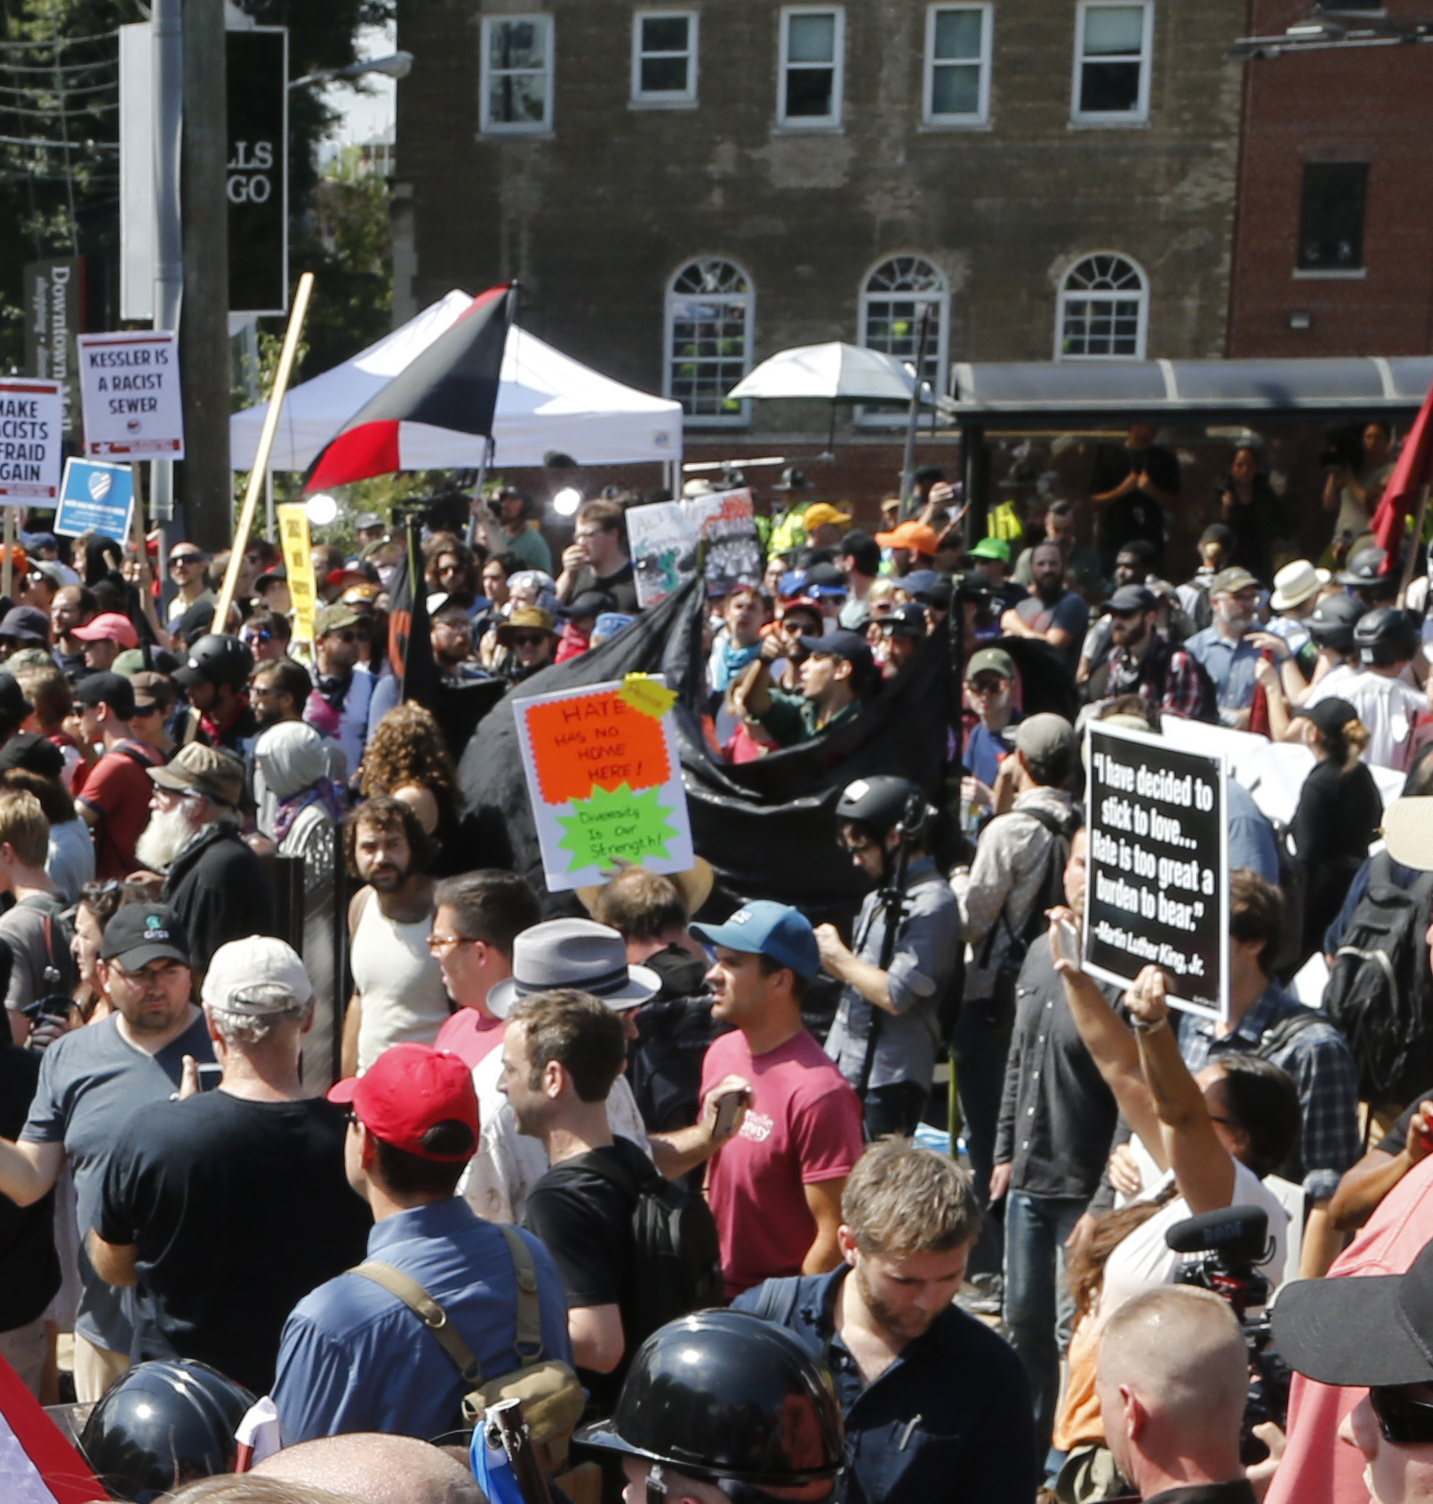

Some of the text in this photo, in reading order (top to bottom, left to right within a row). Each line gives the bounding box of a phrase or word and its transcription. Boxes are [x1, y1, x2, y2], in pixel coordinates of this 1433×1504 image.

[51, 265, 71, 381] Downtown
[89, 347, 169, 368] KESSLER IS
[98, 373, 164, 393] A RACIST
[108, 397, 158, 416] SEWER
[561, 700, 627, 723] HATE
[554, 725, 620, 748] HAS NO
[577, 742, 626, 760] HOME
[1105, 755, 1135, 793] have
[1136, 763, 1192, 808] decided
[1194, 777, 1214, 812] to
[579, 806, 640, 826] Diversity
[1101, 795, 1132, 832] stick
[1134, 803, 1149, 837] to
[1092, 828, 1215, 896] Hate is too great a
[1096, 869, 1139, 914] burden
[1140, 886, 1156, 920] to
[1126, 931, 1159, 961] Luther
